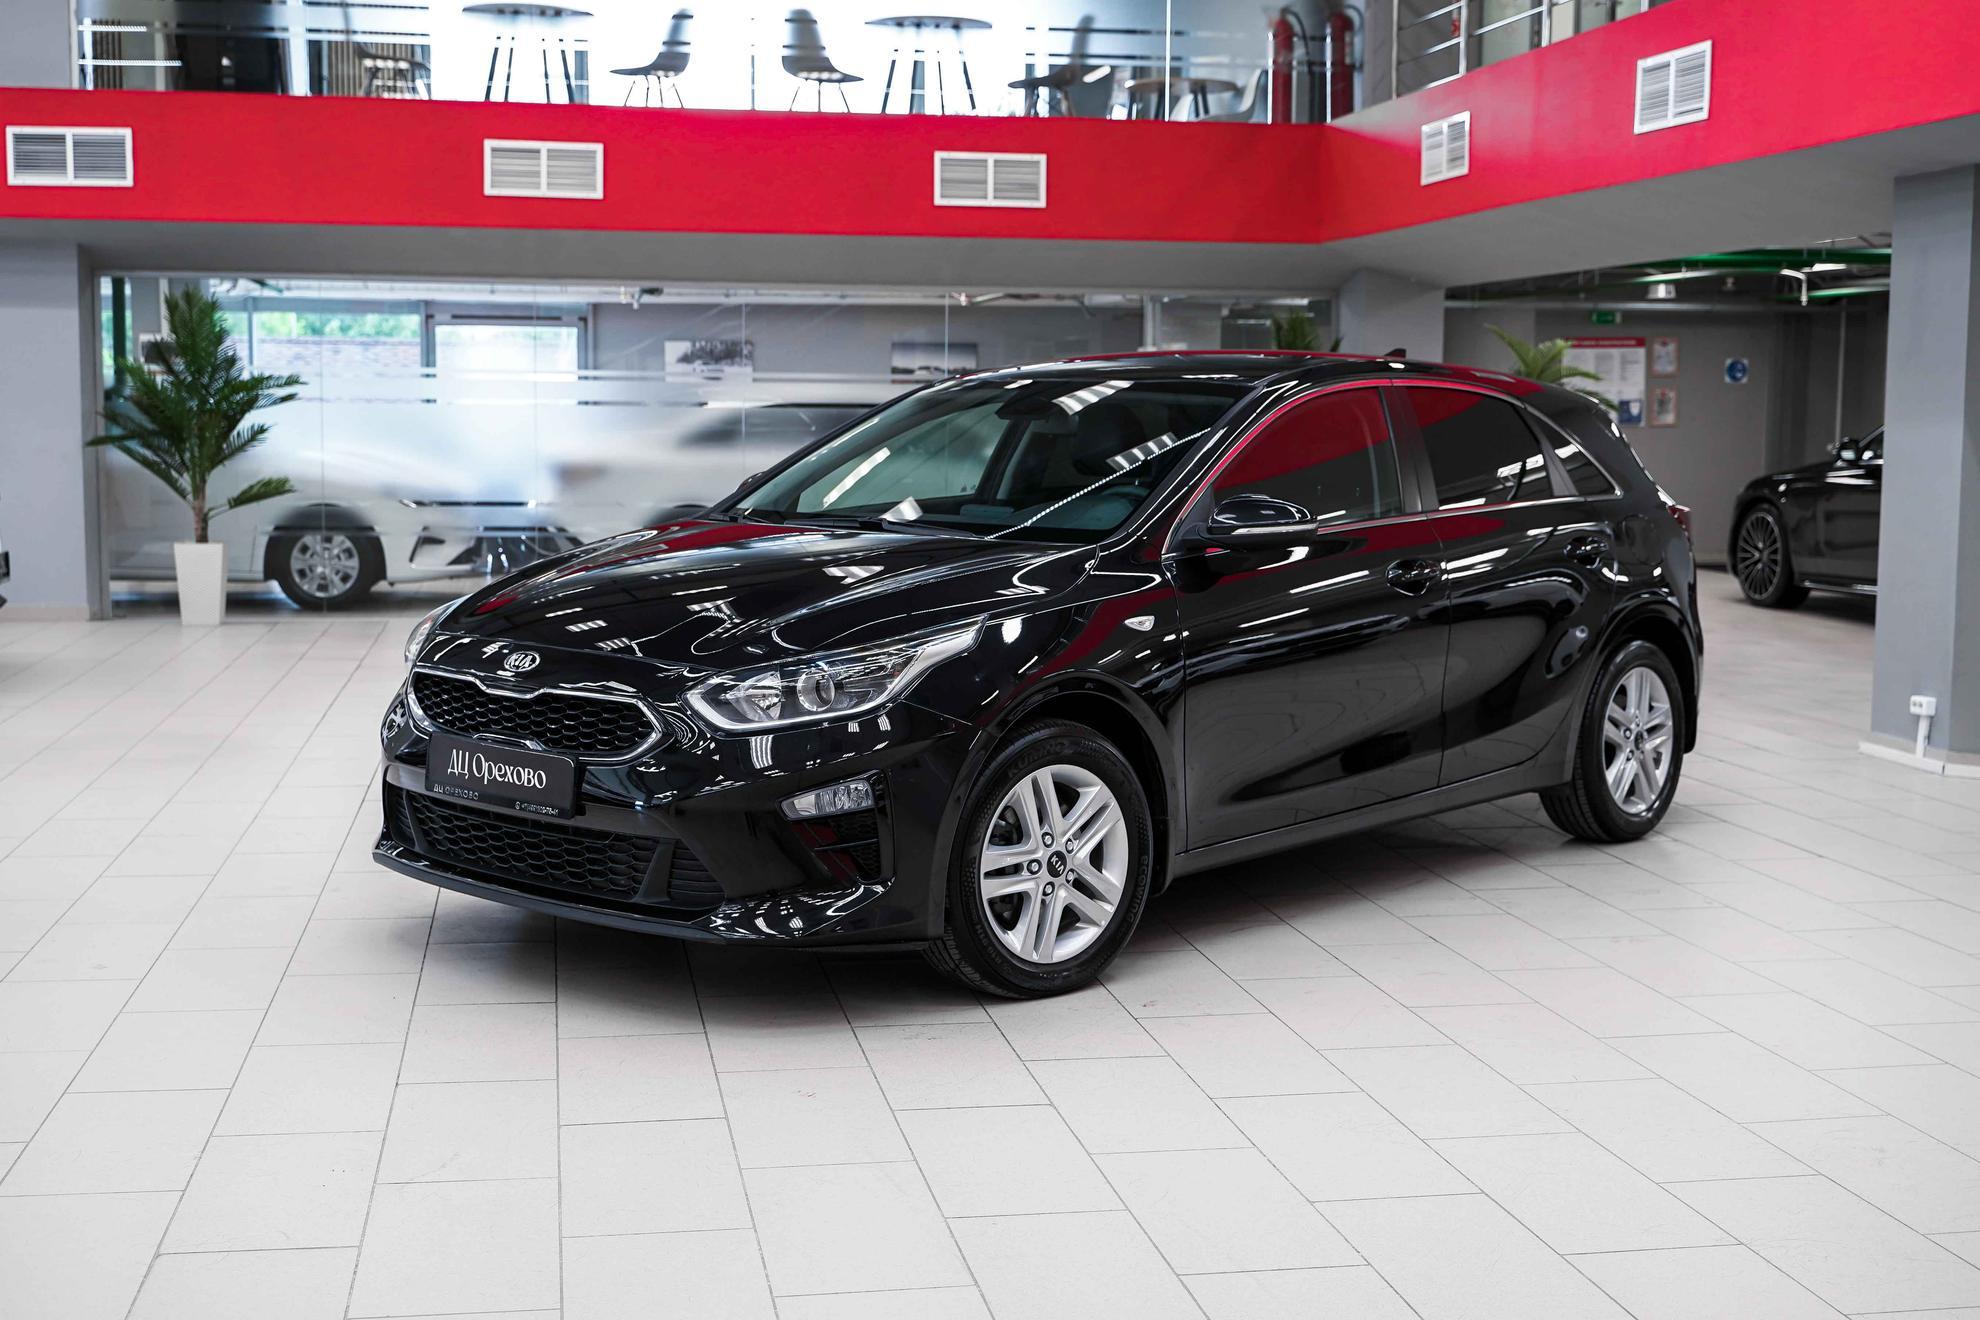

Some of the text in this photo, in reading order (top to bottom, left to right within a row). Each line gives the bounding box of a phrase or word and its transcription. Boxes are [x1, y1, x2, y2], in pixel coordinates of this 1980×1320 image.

[506, 653, 534, 669] KIA
[447, 748, 547, 789] ДЦ Орехово
[1050, 854, 1064, 875] KIA
